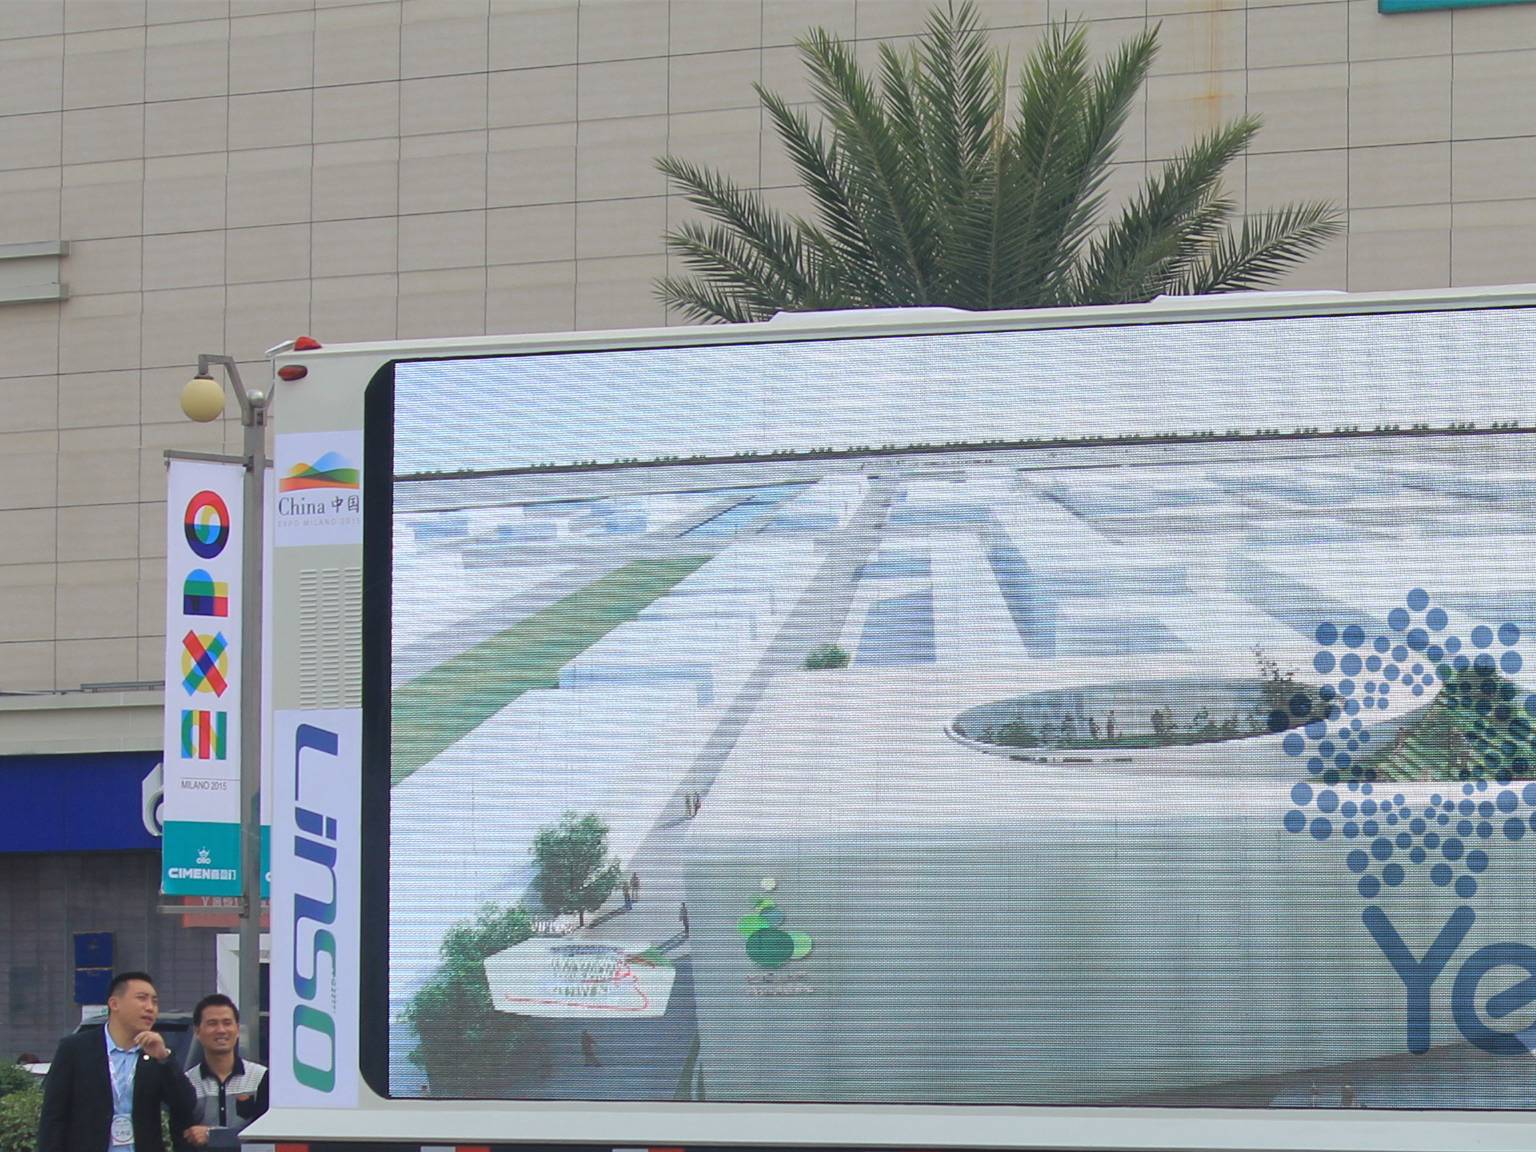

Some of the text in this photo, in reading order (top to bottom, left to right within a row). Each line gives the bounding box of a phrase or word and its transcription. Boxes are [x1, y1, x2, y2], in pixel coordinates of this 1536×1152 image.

[278, 494, 360, 516] China 中国
[181, 780, 228, 792] MILANO 2015
